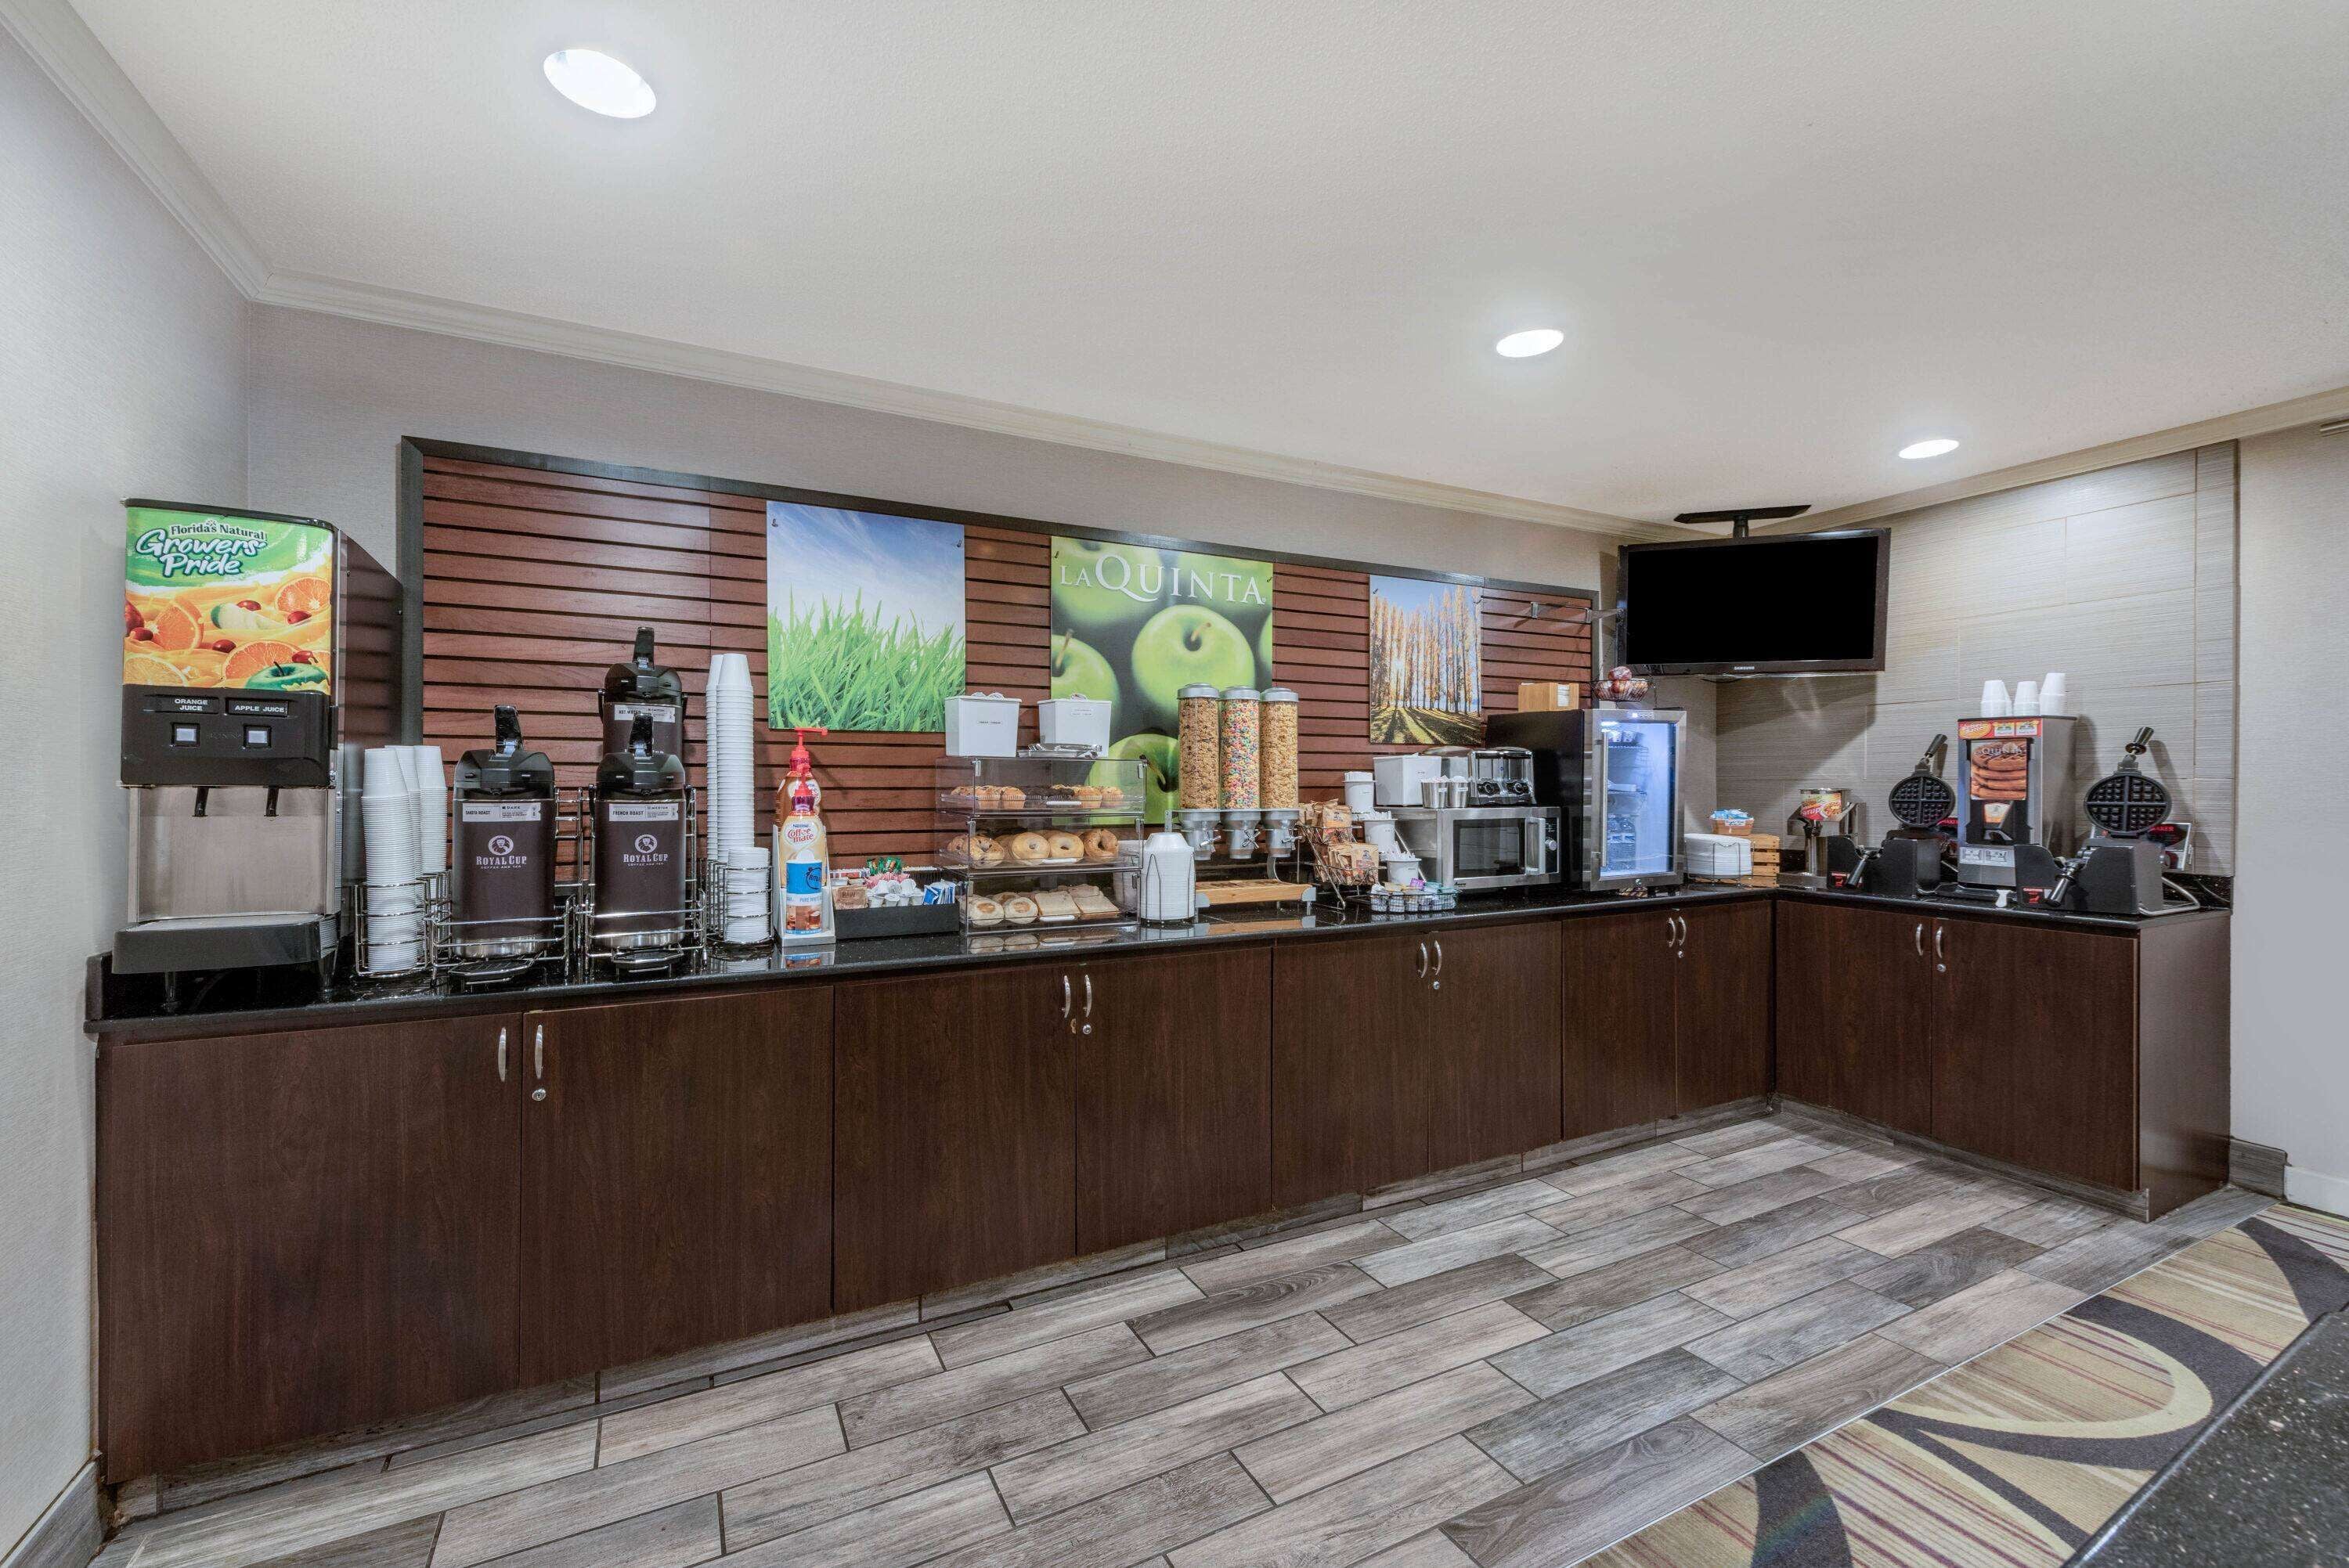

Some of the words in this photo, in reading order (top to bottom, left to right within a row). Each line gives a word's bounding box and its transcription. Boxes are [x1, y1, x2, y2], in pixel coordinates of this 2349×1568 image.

[159, 552, 244, 578] Pride
[1060, 564, 1092, 587] LA
[1095, 553, 1265, 604] QUINTA
[476, 856, 507, 866] ROYAL
[509, 855, 527, 865] CUP
[623, 853, 651, 863] ROYAL
[653, 853, 668, 862] CUP
